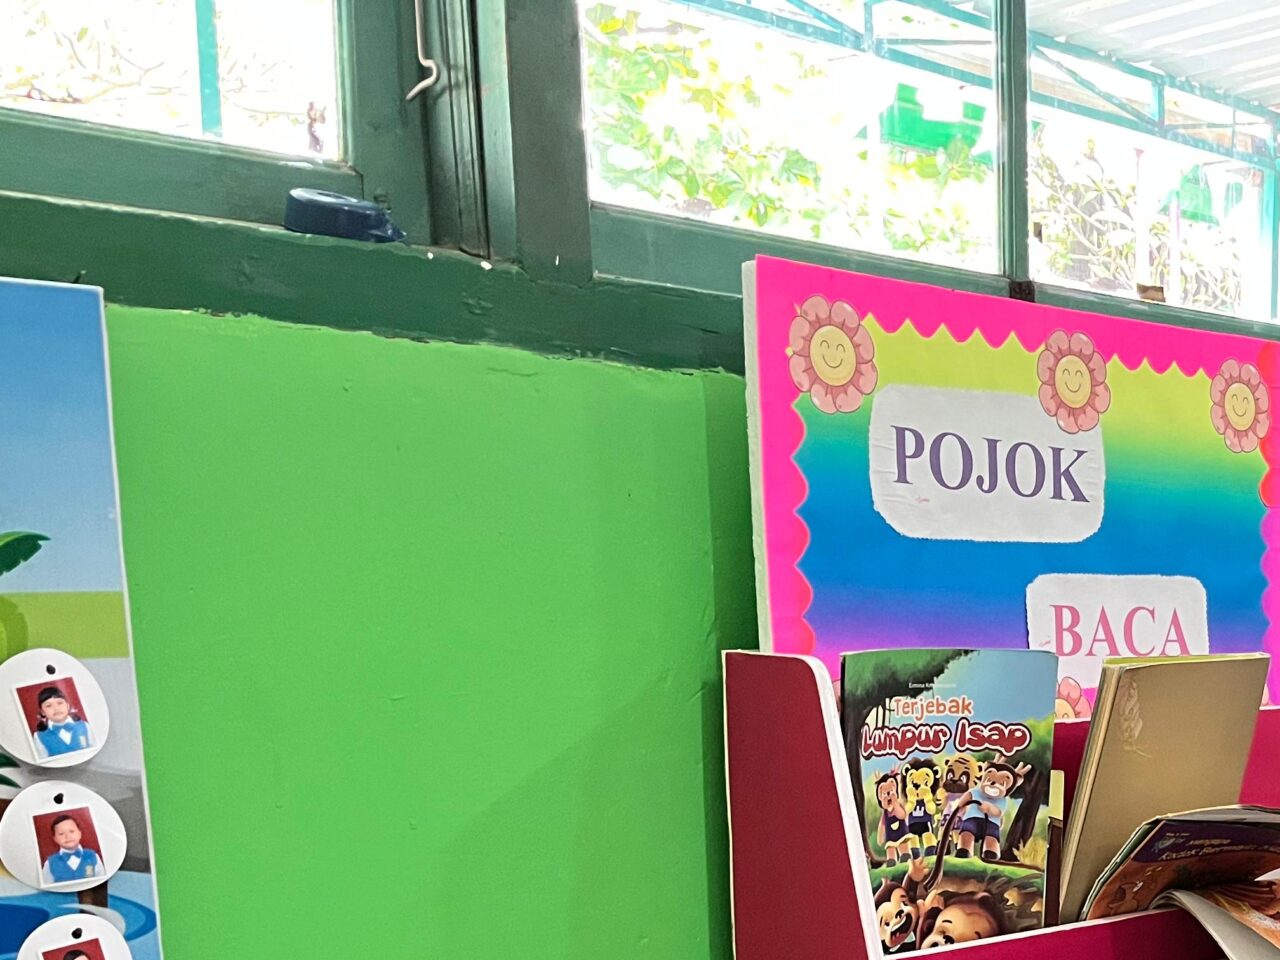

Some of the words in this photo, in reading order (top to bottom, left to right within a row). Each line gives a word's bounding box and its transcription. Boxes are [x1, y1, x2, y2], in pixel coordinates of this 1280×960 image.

[890, 424, 1090, 504] POJOK
[1048, 603, 1192, 659] BACA
[895, 696, 974, 721] Terjebak
[861, 722, 951, 761] Lumpur
[954, 718, 1031, 758] Isap
